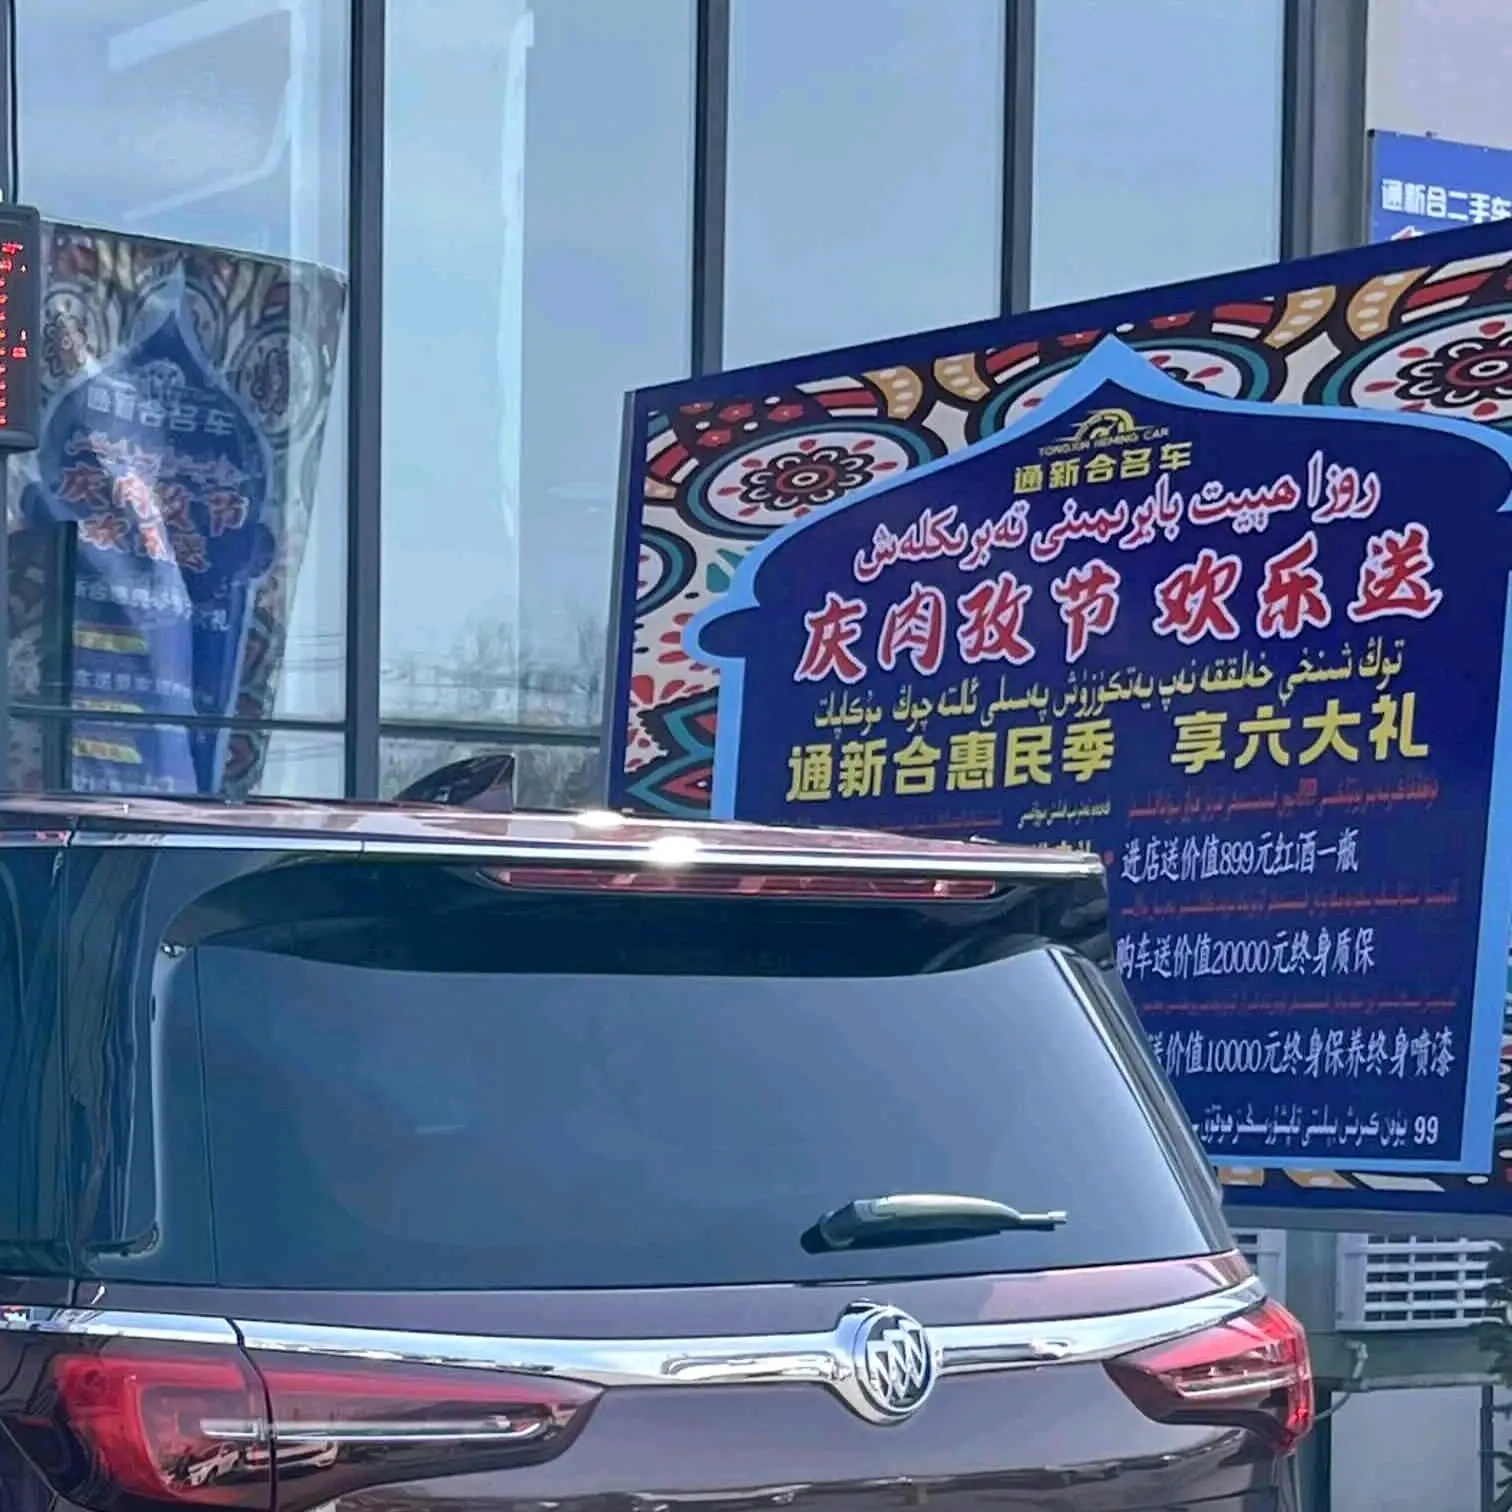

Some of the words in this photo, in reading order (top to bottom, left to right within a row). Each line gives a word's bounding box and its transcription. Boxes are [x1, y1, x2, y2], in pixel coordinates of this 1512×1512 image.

[1143, 426, 1170, 441] CAR
[1013, 441, 1192, 494] 通新合名车
[787, 717, 1116, 802] 通新合惠民季
[1170, 691, 1429, 774] 享六大礼
[1121, 826, 1360, 884] 进店送价值899元红酒一瓶
[1116, 927, 1376, 981] 购车送价值20000元终身质保
[1414, 1114, 1439, 1144] 99
